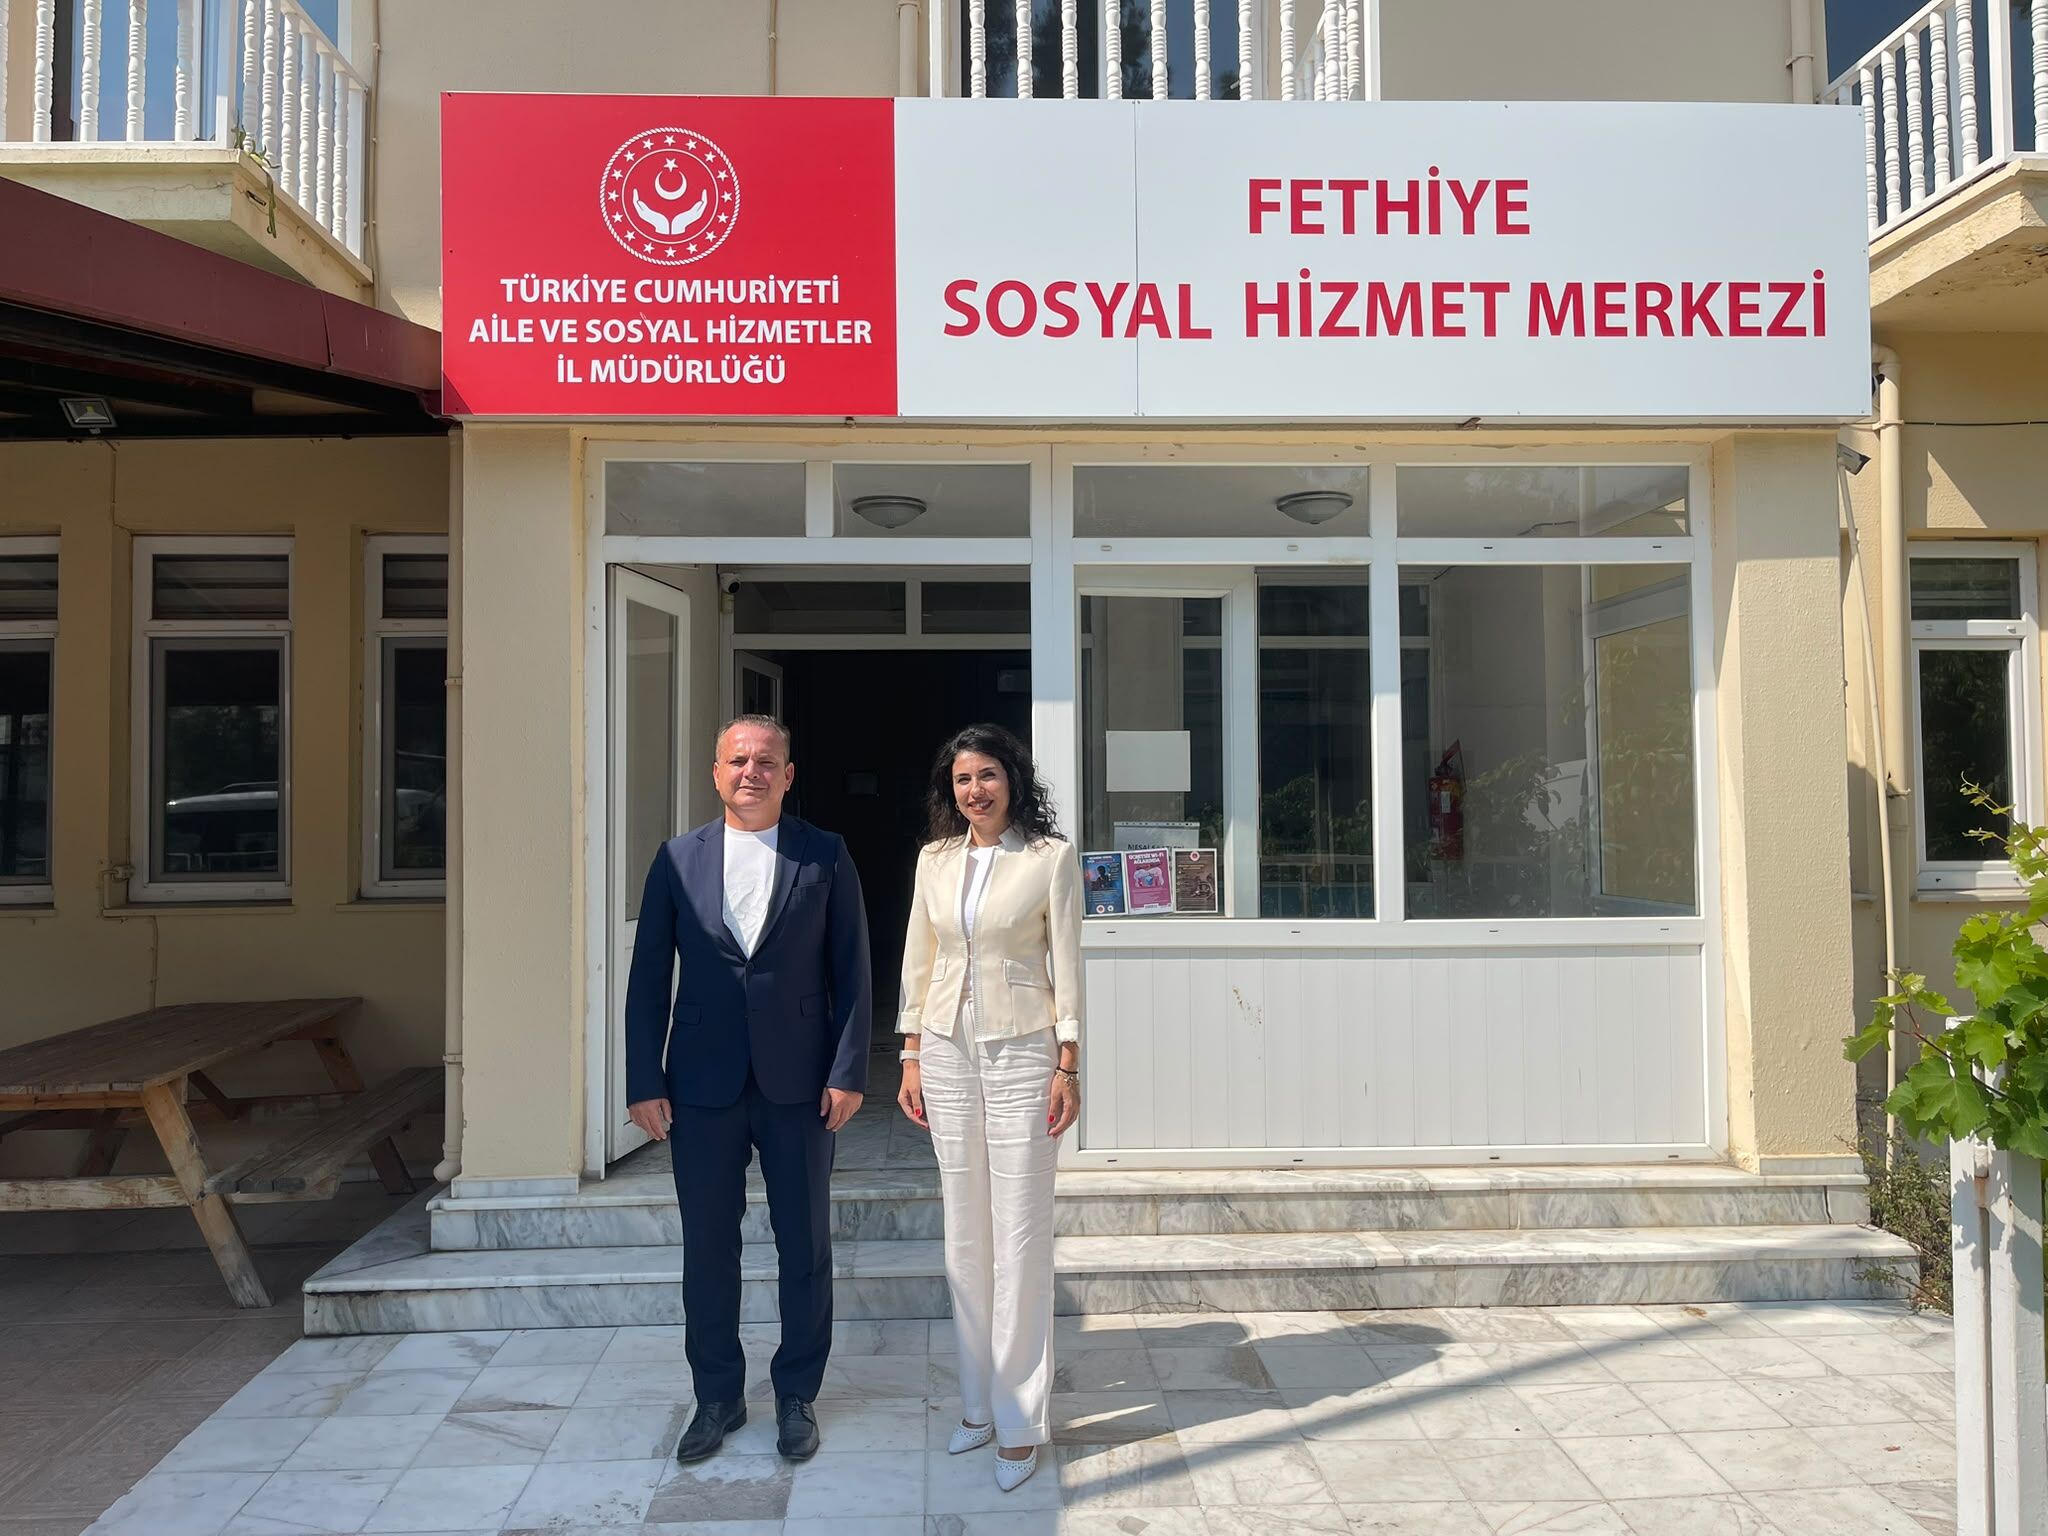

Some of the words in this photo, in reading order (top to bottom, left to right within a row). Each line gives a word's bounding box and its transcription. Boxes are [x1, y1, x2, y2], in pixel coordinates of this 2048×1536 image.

[1248, 165, 1531, 236] FETHİYE
[500, 273, 627, 304] TÜRKİYE
[634, 273, 840, 304] CUMHURİYETİ
[943, 278, 1213, 340] SOSYAL
[1245, 267, 1511, 338] HİZMET
[1528, 268, 1827, 337] MERKEZİ
[468, 313, 534, 343] AİLE
[539, 318, 578, 343] VE
[585, 318, 699, 344] SOSYAL
[706, 314, 872, 344] HİZMETLER
[557, 353, 583, 383] İL
[590, 353, 786, 384] MÜDÜRLÜĞÜ
